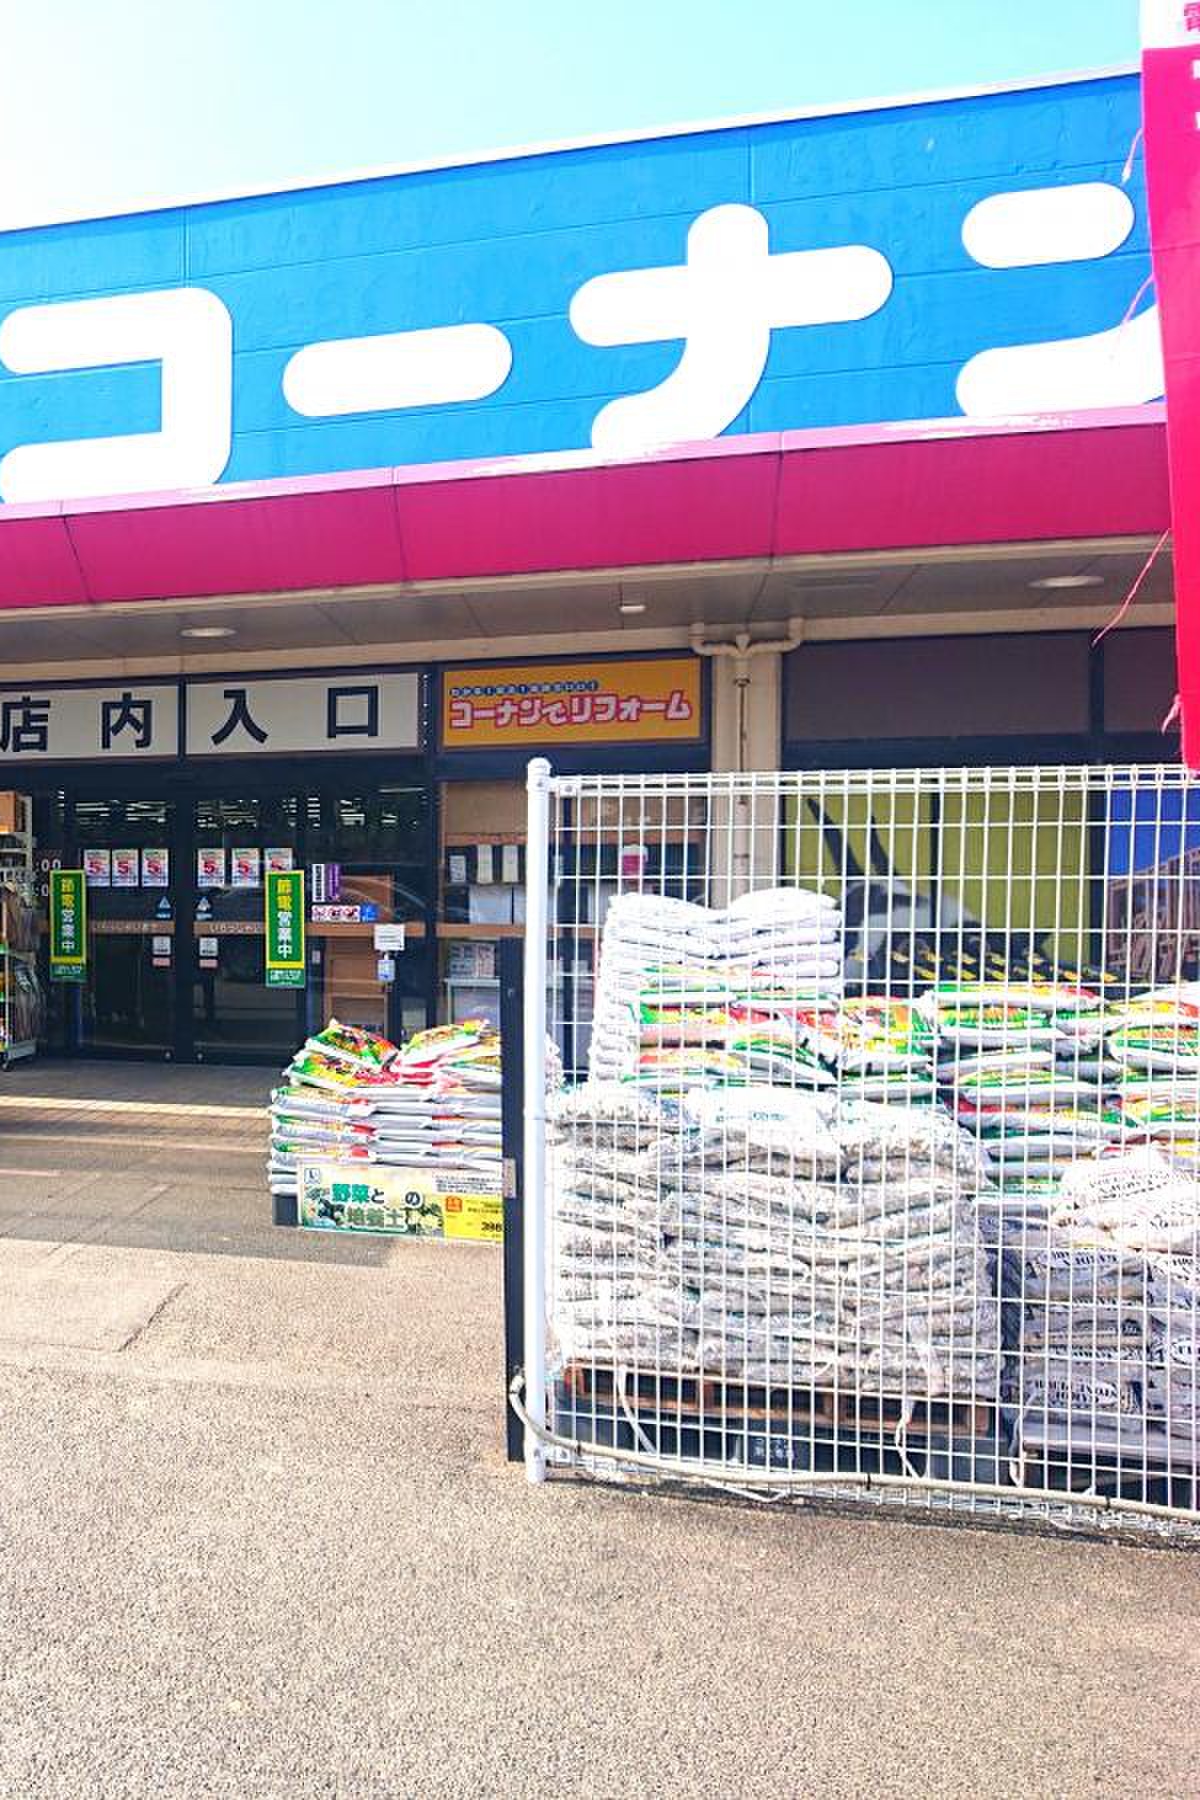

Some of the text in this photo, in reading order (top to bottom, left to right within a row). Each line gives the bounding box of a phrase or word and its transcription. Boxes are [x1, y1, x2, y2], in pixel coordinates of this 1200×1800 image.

[450, 690, 693, 729] コーナンでリフォーム
